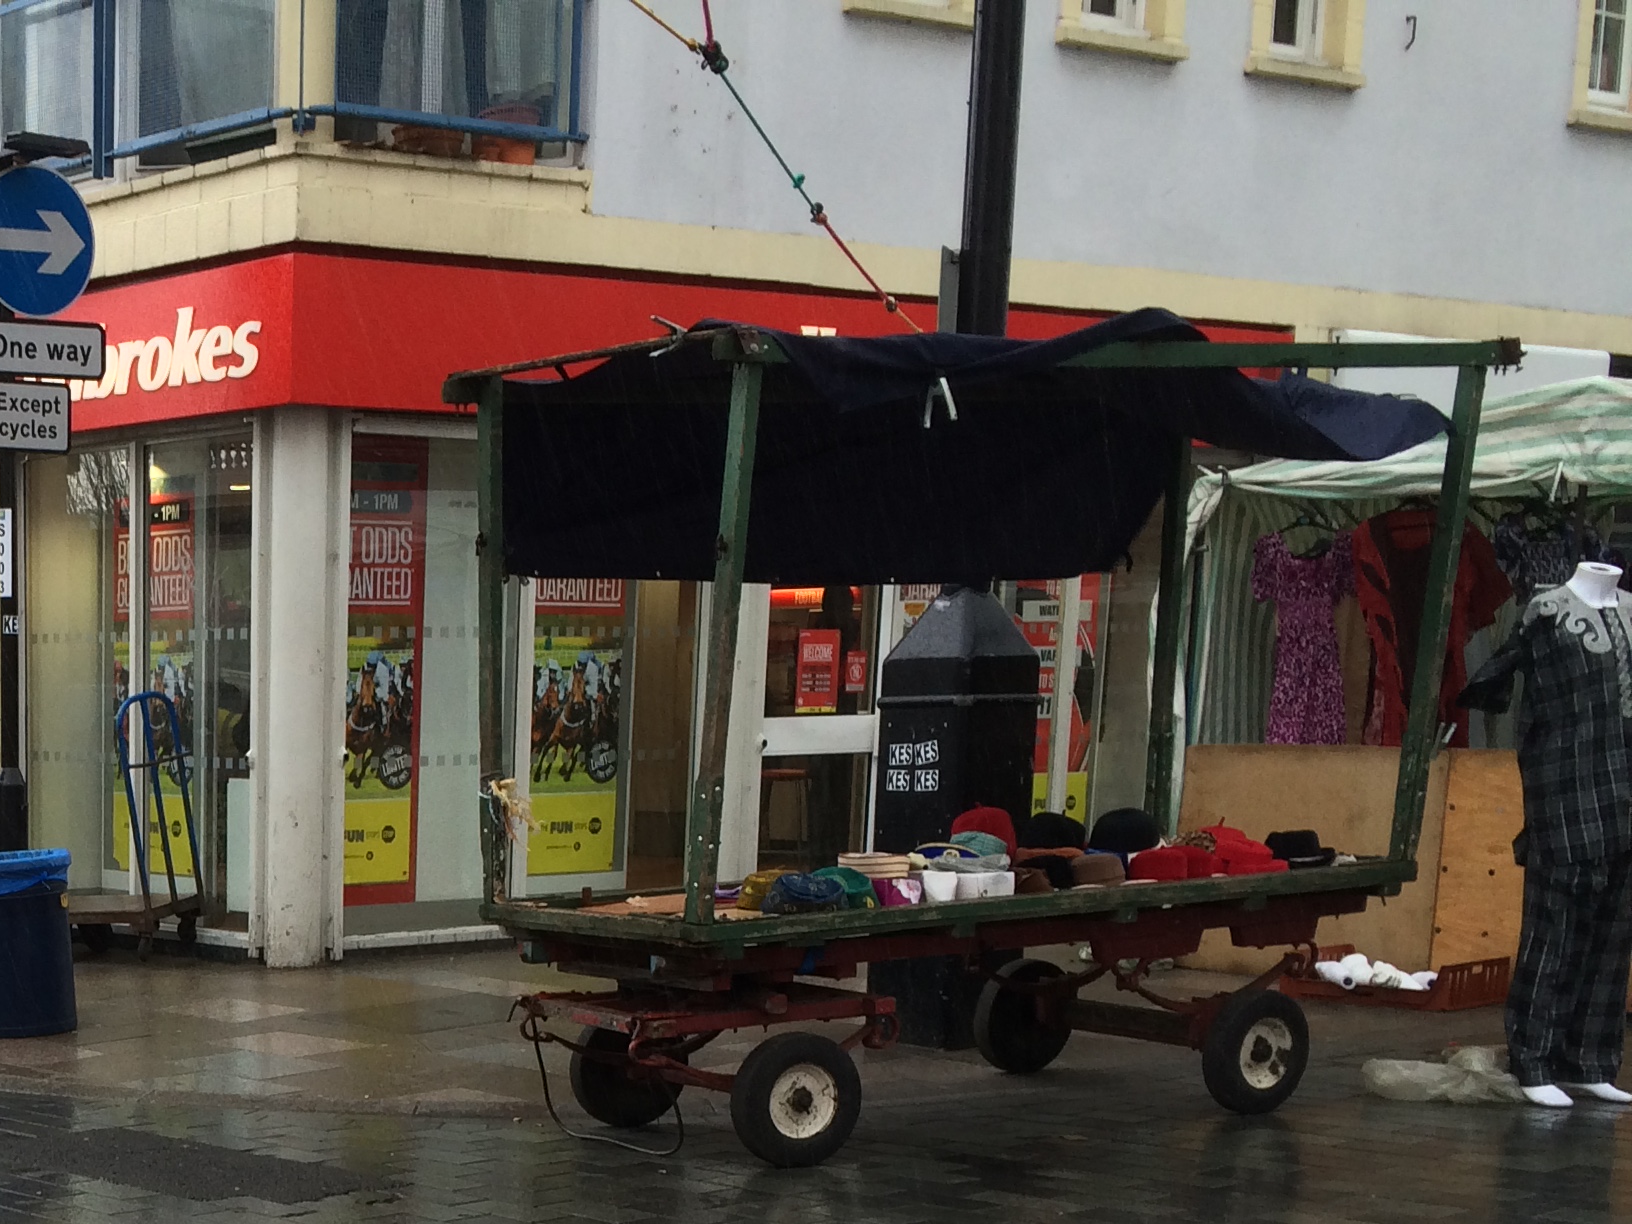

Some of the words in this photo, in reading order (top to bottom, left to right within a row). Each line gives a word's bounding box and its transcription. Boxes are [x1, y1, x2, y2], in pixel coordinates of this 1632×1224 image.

[23, 306, 263, 402] brokes
[46, 344, 92, 367] way
[161, 504, 180, 521] 1PM
[373, 493, 399, 511] 1PM
[153, 535, 191, 573] ODDS
[361, 525, 413, 564] ODDS
[348, 567, 414, 600] ANTEED
[537, 578, 622, 602] UARANTEED
[3, 616, 18, 634] KE
[803, 643, 833, 663] WELCOME
[890, 744, 912, 763] KES
[915, 741, 938, 763] KES
[887, 770, 909, 790] KES
[915, 770, 938, 790] KES
[550, 820, 573, 834] FUN
